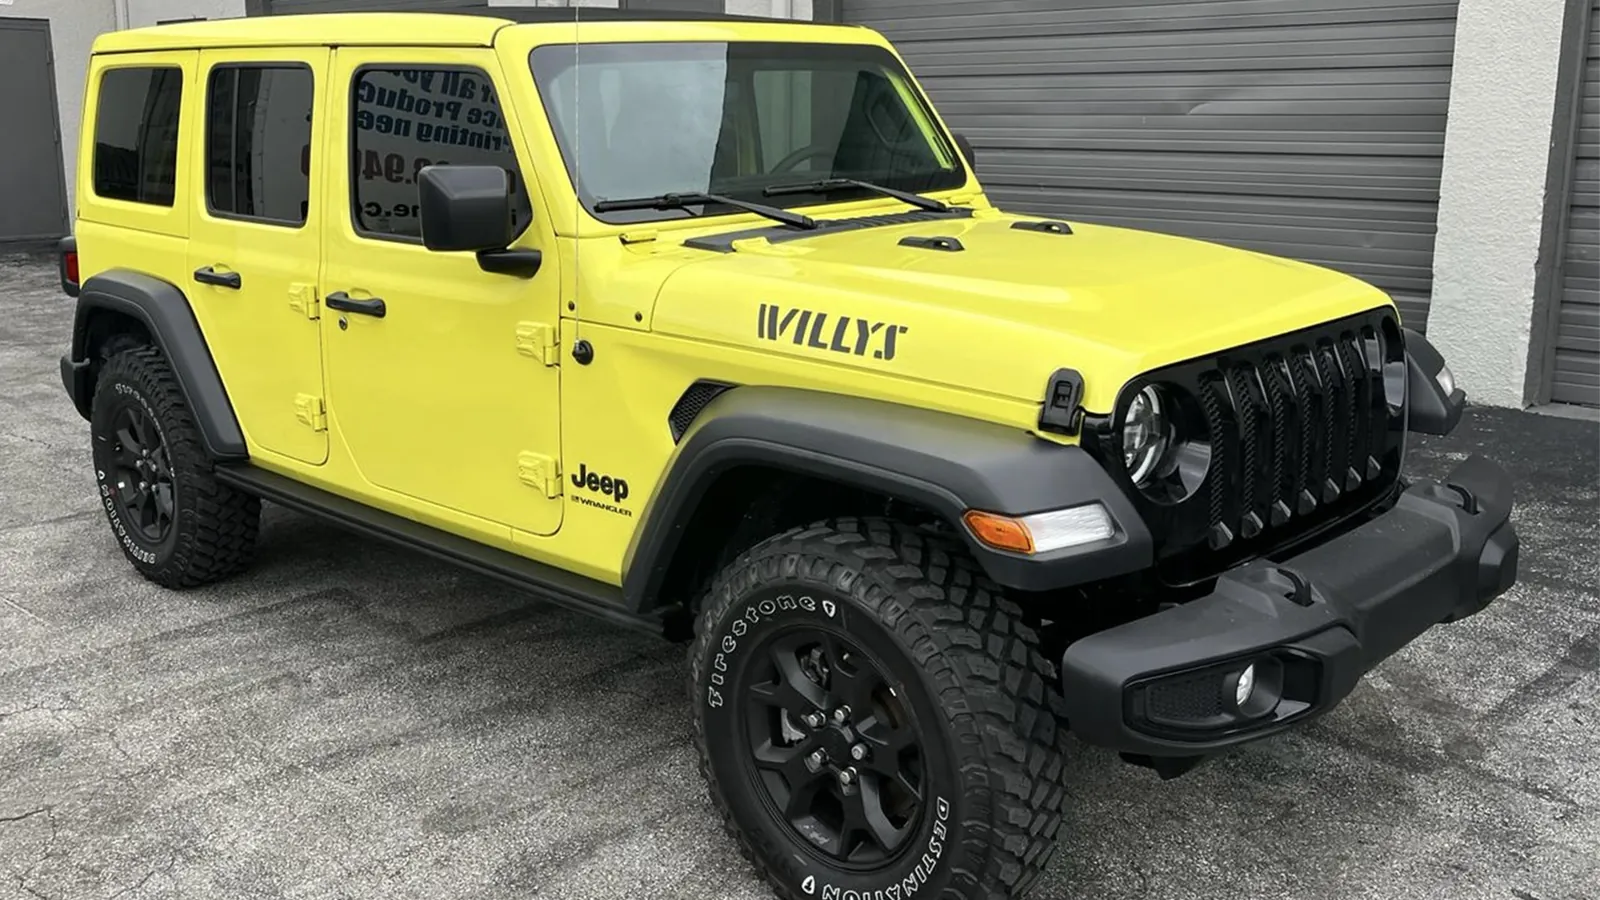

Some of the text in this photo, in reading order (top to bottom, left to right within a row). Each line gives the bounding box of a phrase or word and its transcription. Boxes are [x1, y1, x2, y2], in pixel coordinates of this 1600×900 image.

[758, 303, 908, 360] WILLYS
[571, 463, 629, 503] Jeep
[580, 497, 632, 517] WRANGLER
[708, 595, 816, 708] Firestone
